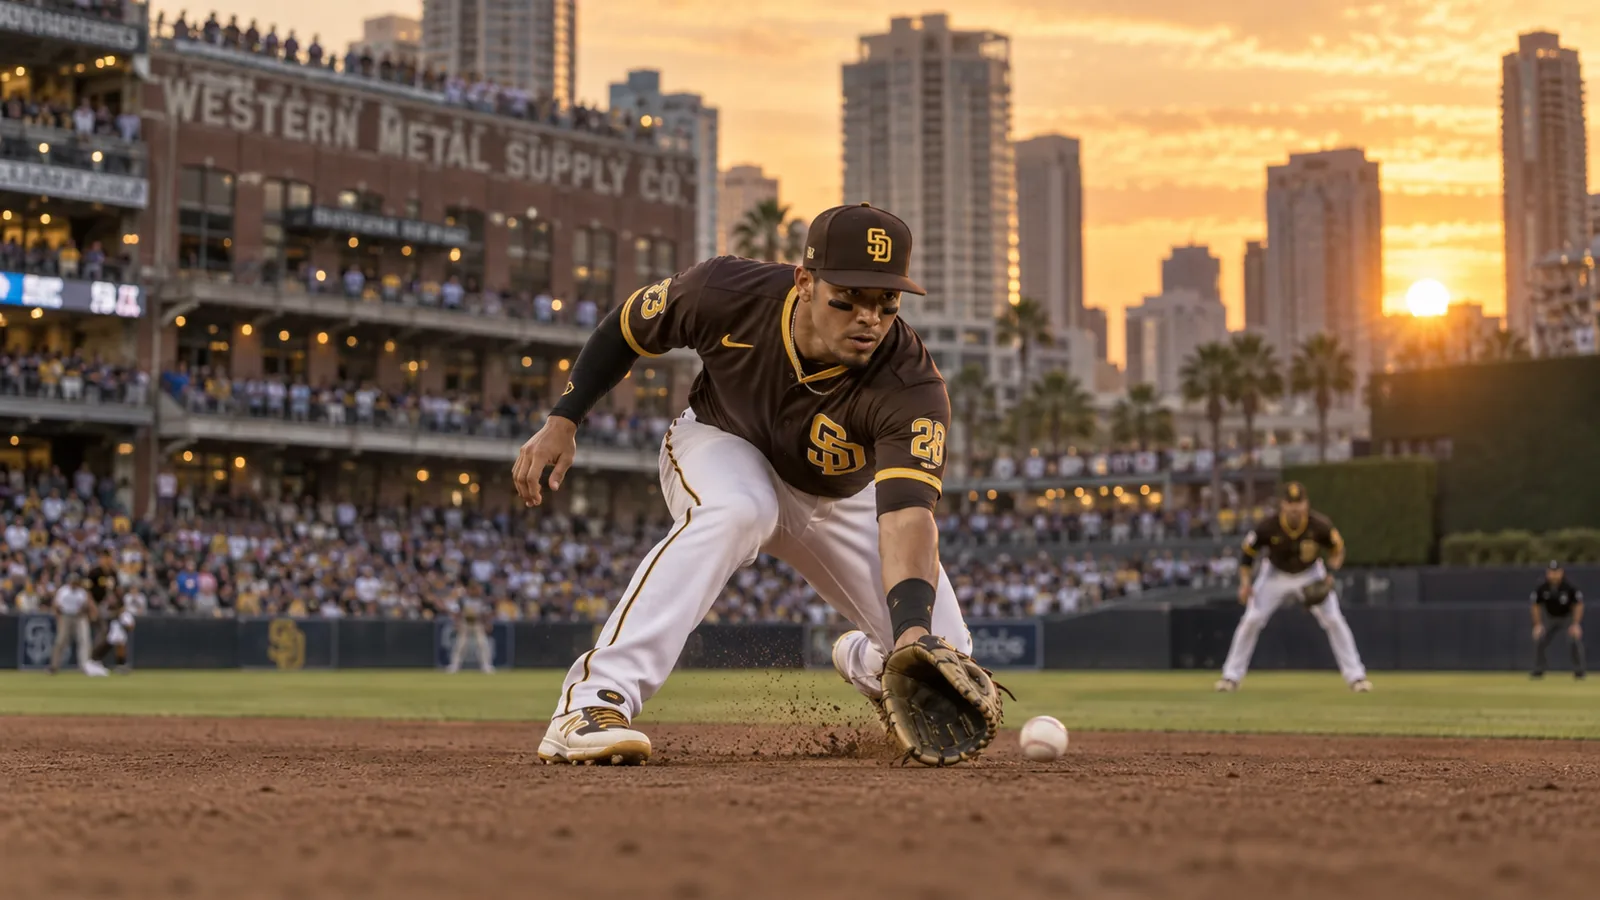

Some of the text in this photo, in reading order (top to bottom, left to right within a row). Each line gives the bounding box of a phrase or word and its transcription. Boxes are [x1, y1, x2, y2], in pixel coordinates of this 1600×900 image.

[163, 77, 361, 148] WESTERN
[380, 105, 492, 172] METAL
[505, 142, 630, 196] SUPPLY
[867, 227, 893, 263] SD
[807, 412, 867, 476] SD
[910, 417, 947, 467] 28
